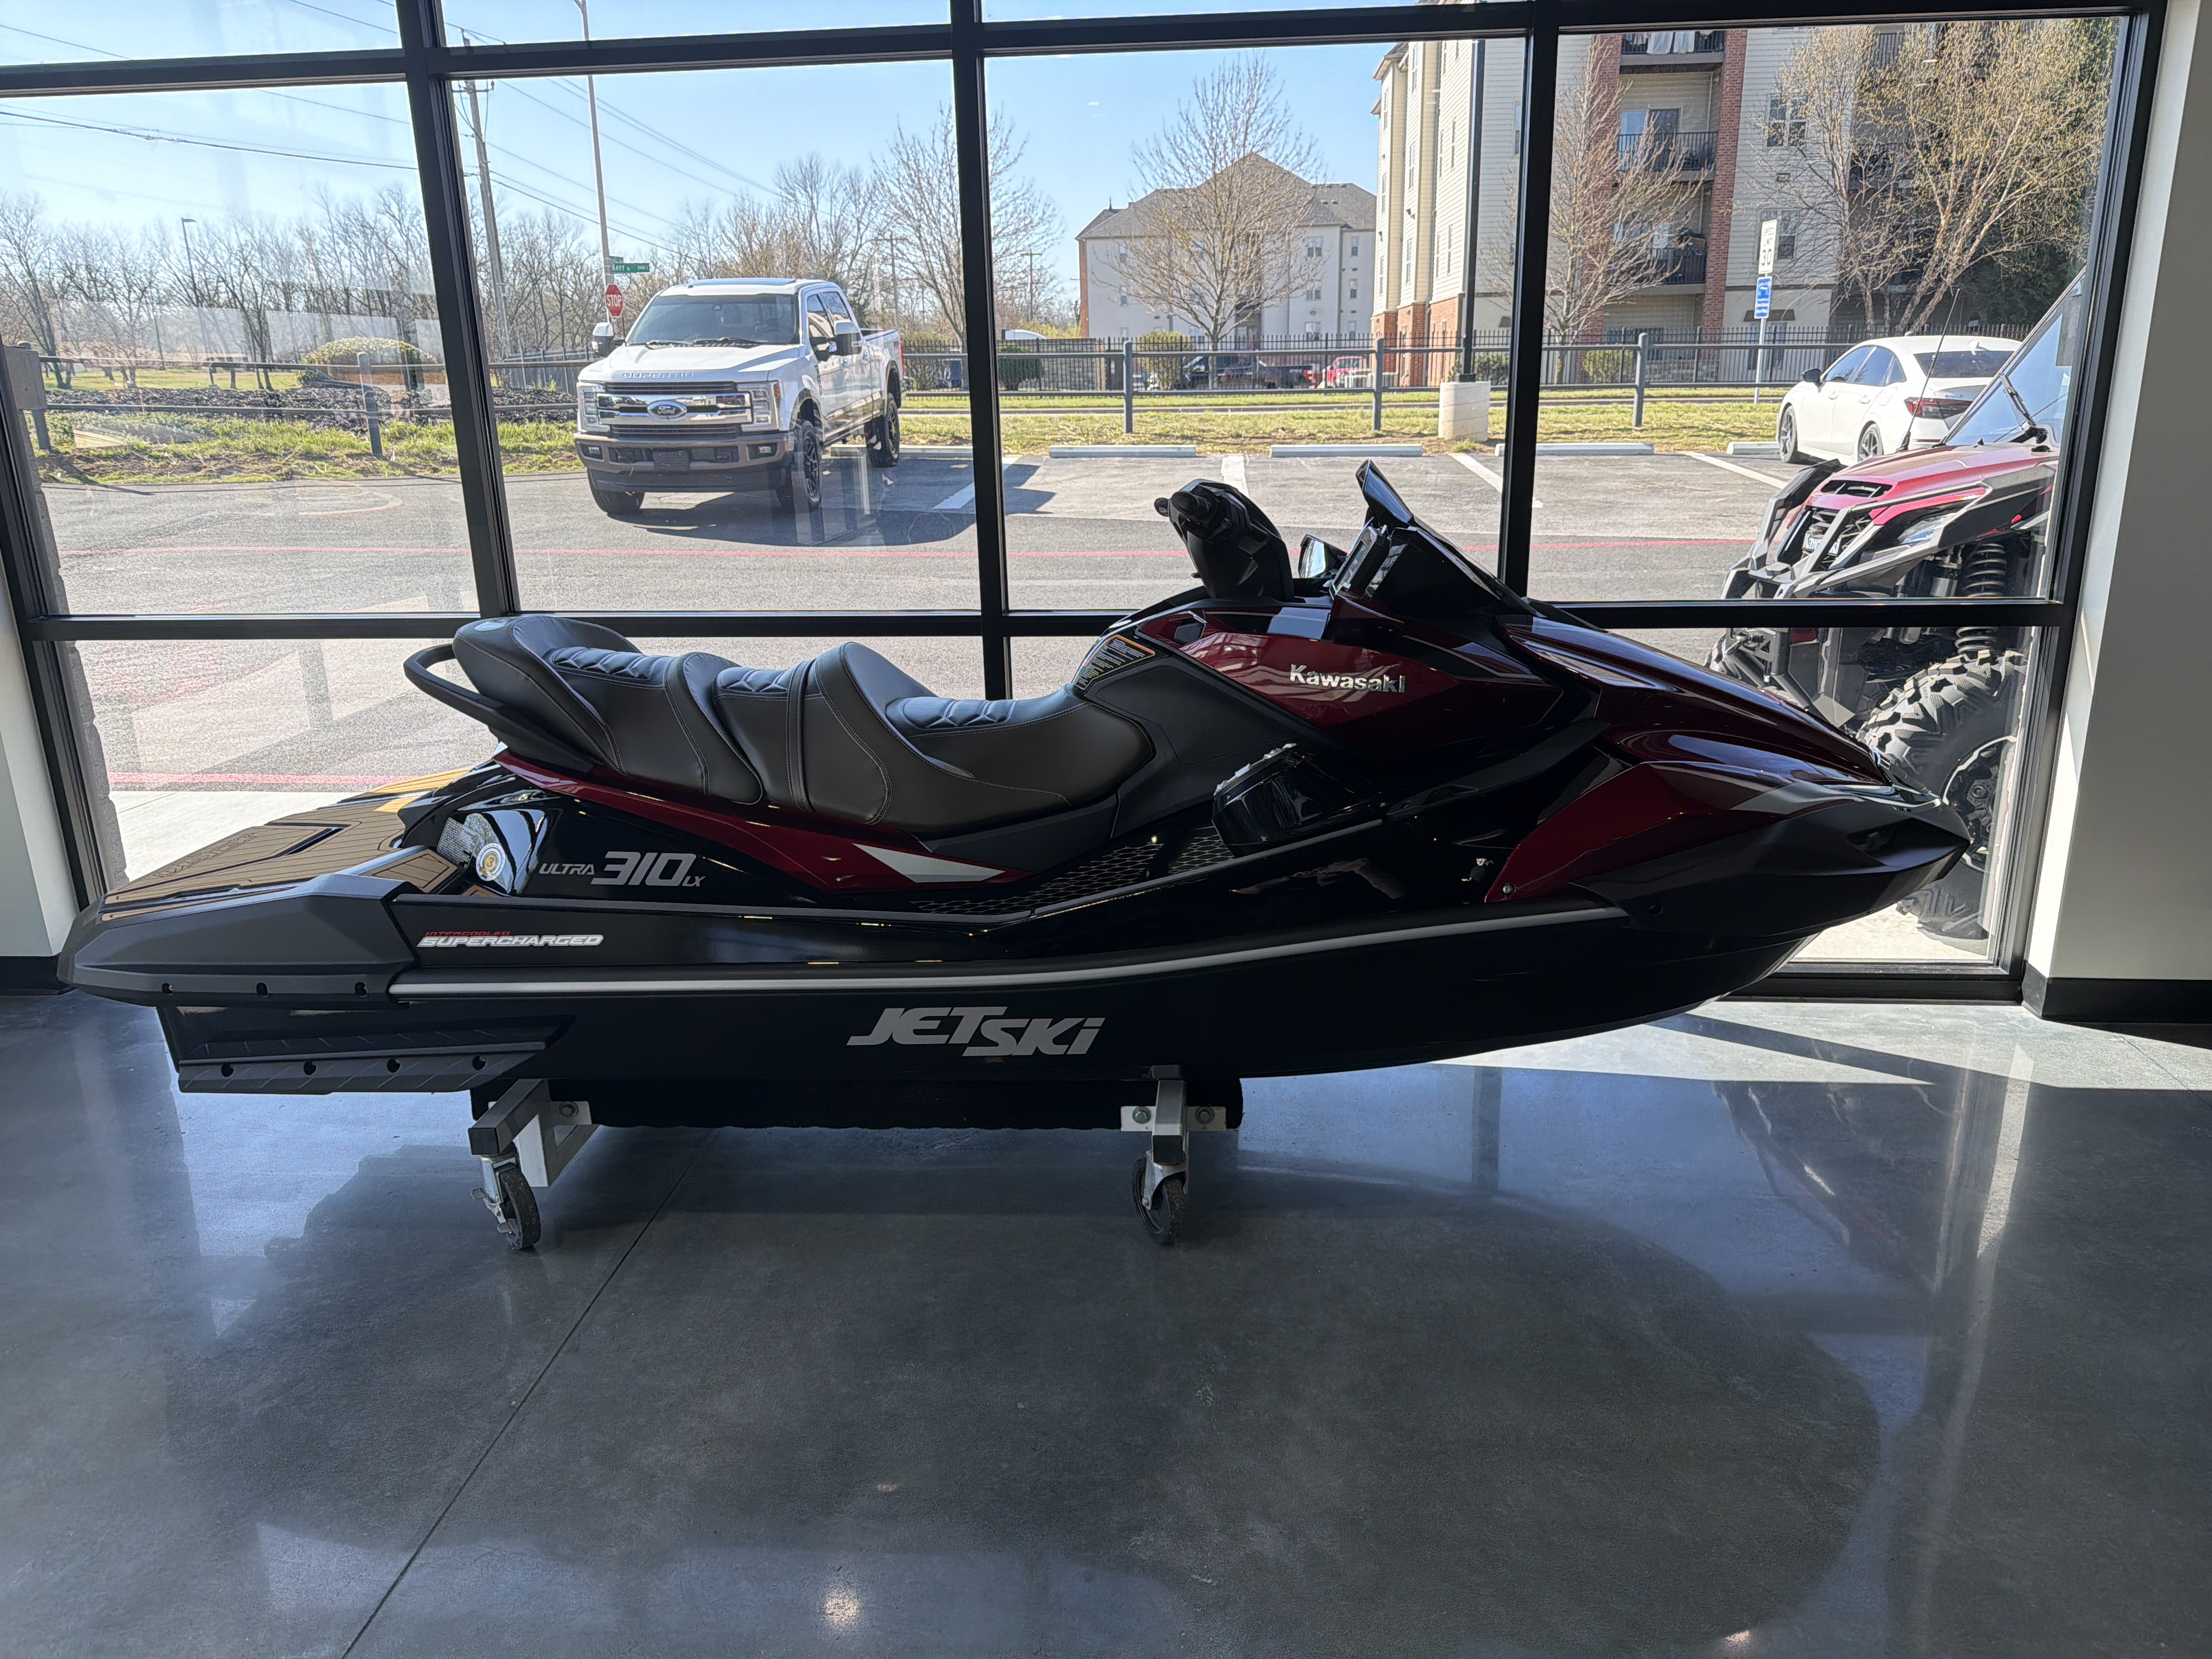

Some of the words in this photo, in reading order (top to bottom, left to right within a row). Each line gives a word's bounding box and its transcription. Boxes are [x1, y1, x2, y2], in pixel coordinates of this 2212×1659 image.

[1761, 248, 1772, 267] 30
[606, 294, 622, 307] STOP
[657, 405, 676, 415] Ford
[1290, 663, 1406, 693] Kawasaki
[487, 856, 494, 868] 3
[539, 863, 595, 876] ULTRA
[590, 851, 696, 887] 310
[682, 876, 706, 887] LX
[417, 934, 604, 947] SUPERCHARGED
